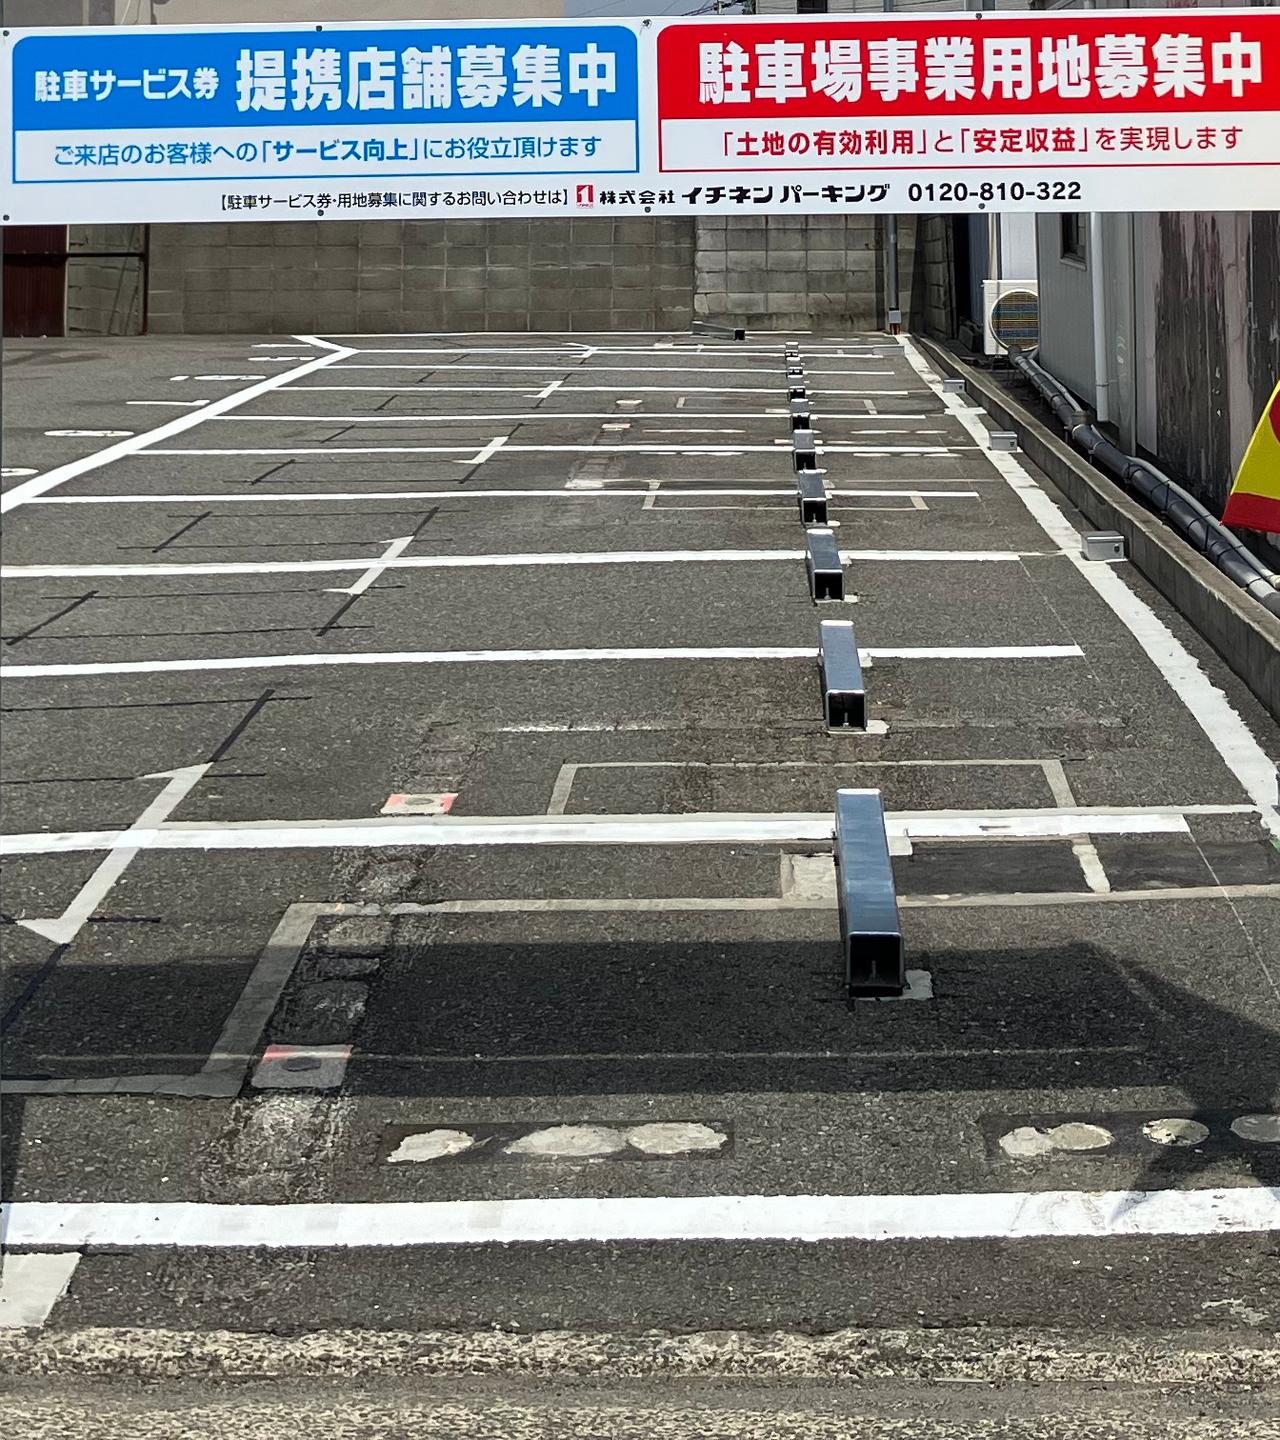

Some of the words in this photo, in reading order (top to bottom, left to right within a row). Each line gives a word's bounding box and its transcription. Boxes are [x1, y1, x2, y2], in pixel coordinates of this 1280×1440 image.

[35, 66, 219, 103] 駐車サービス券
[235, 42, 616, 113] 提携店舗募集中
[699, 31, 1262, 104] 駐車場事業用地募集中
[54, 135, 602, 167] ご来店のお客様への「サービス向上」にお役立頂けます
[722, 126, 1243, 158] 「土地の有効利用」と「安定収益」を実現します
[600, 190, 675, 205] 株式会社
[908, 182, 1081, 202] 0120-810-322
